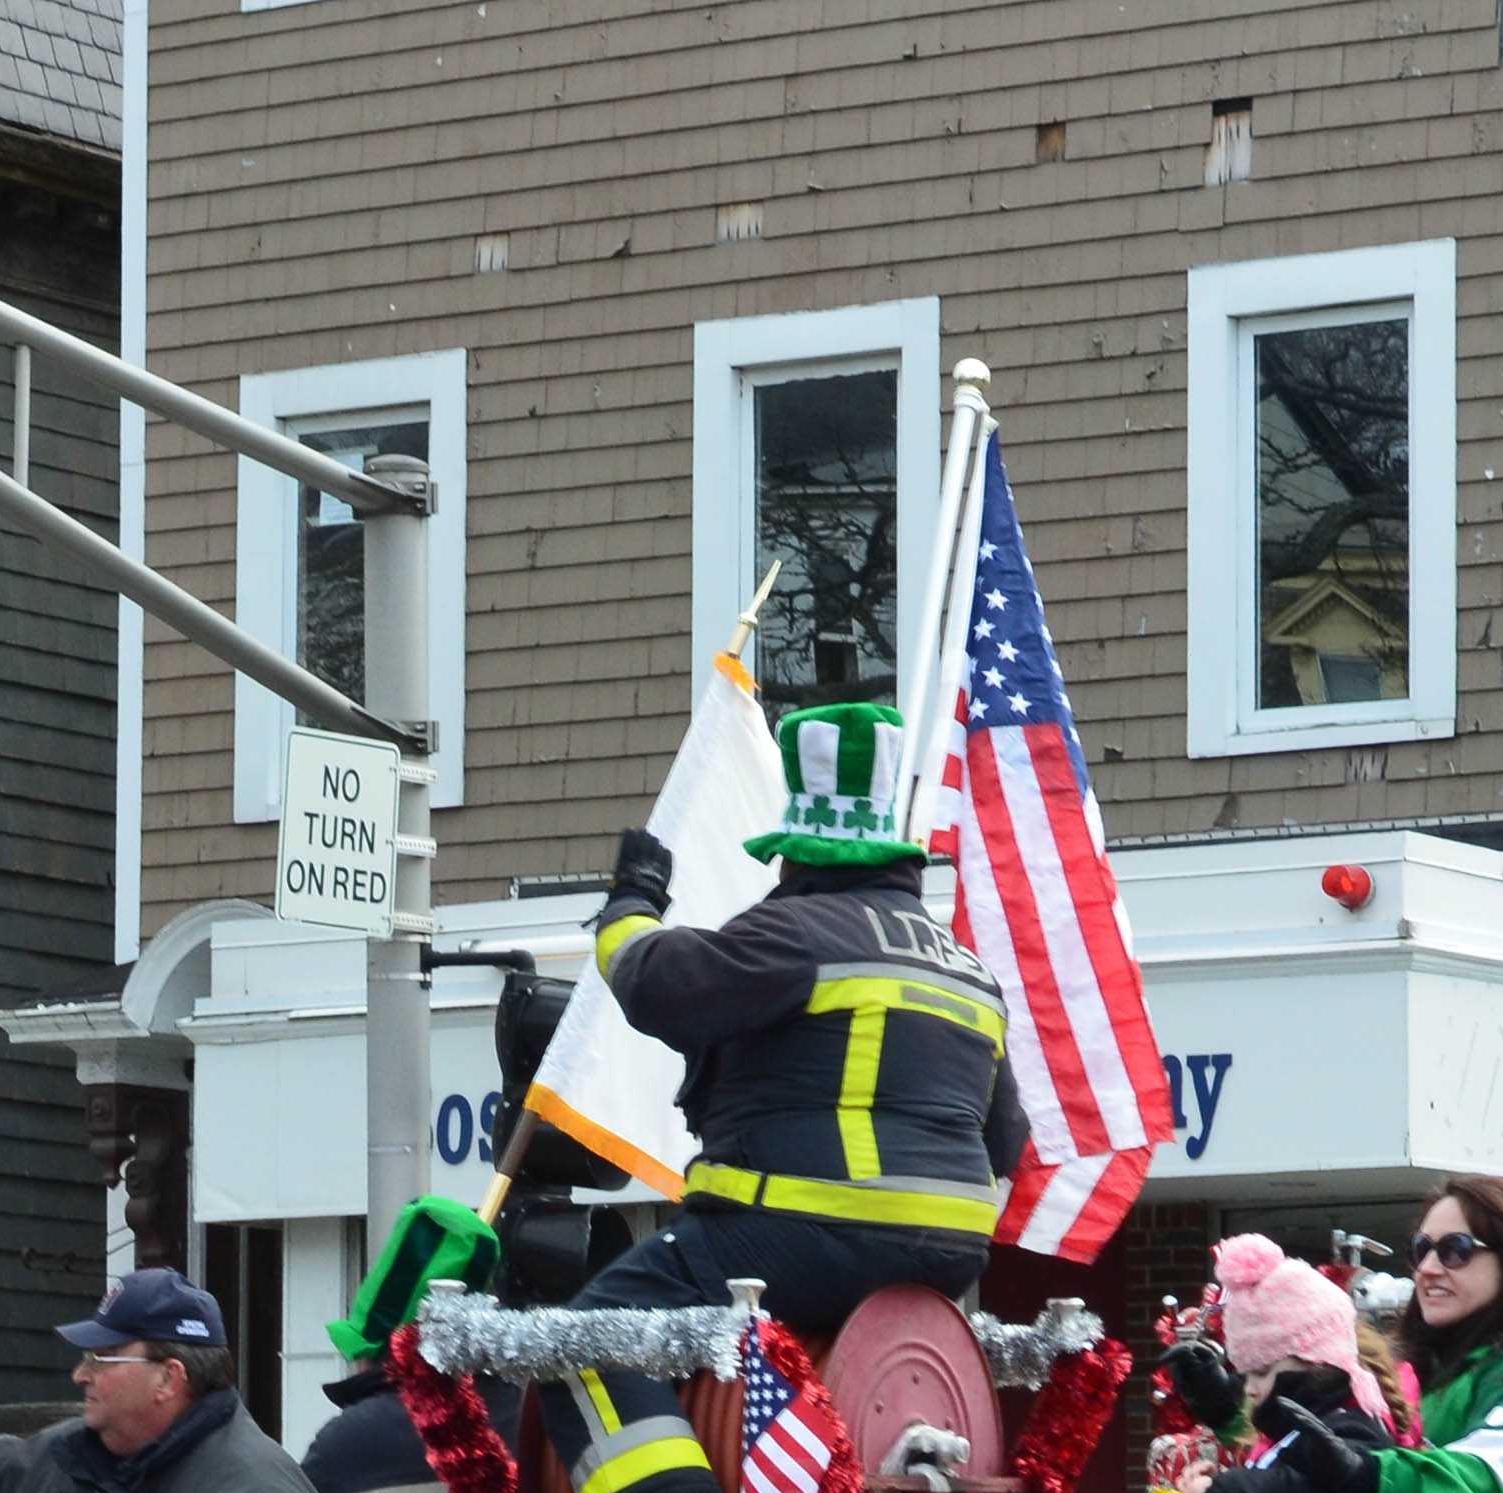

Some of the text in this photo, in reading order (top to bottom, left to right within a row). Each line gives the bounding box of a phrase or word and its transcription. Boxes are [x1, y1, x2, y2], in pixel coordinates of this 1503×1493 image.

[322, 764, 360, 802] NO
[303, 811, 376, 854] TURN
[286, 860, 387, 904] ON RED
